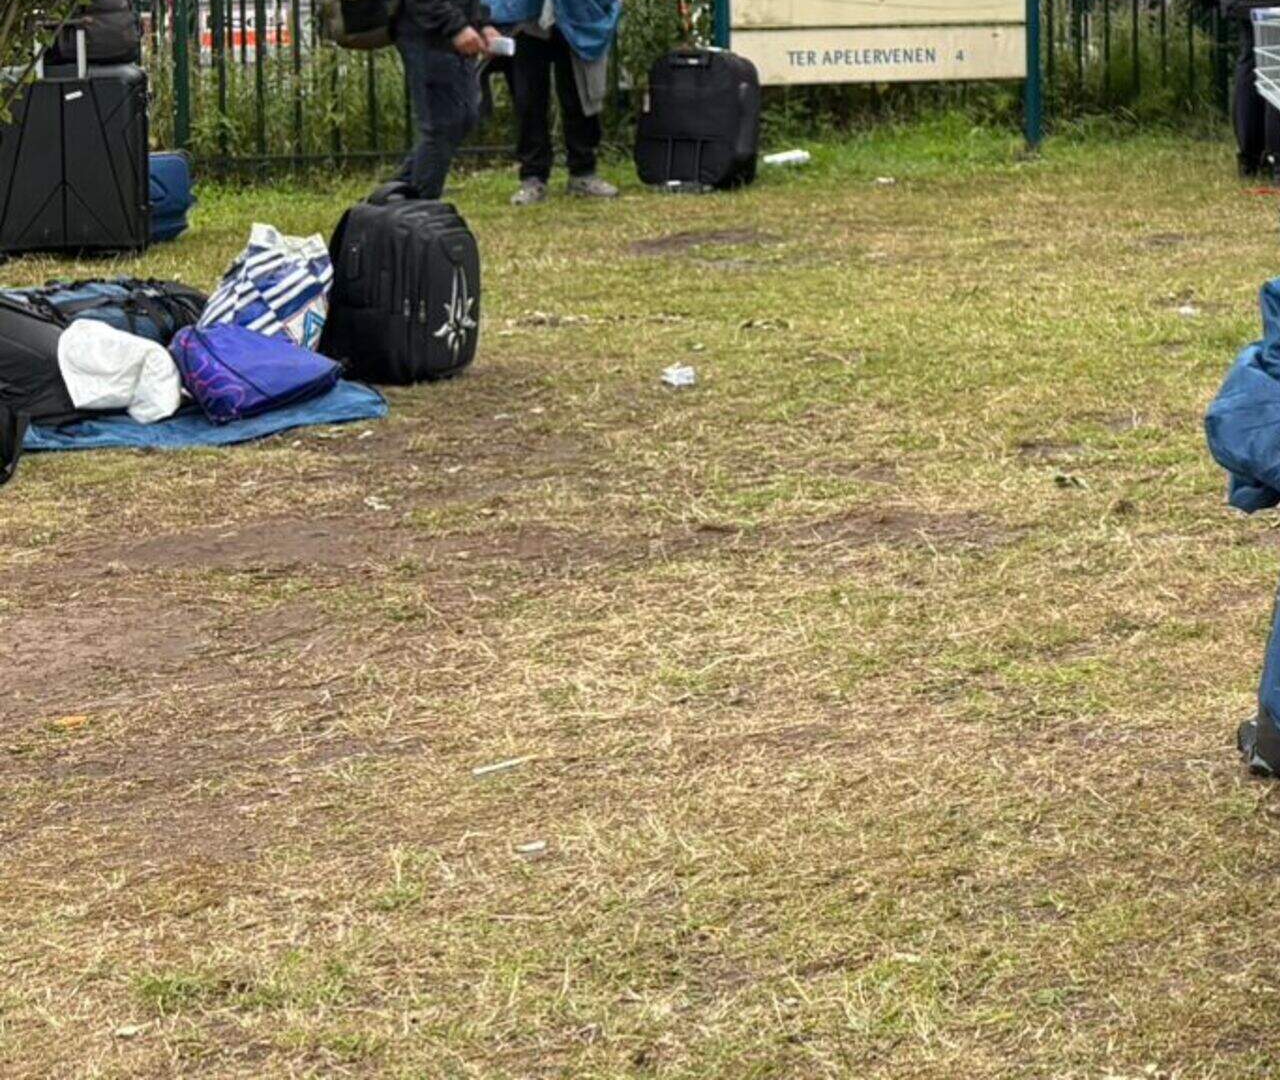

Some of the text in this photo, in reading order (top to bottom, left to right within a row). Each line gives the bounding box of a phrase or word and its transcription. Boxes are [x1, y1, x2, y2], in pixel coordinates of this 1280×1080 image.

[788, 48, 964, 66] TER APELERVENEN 4
